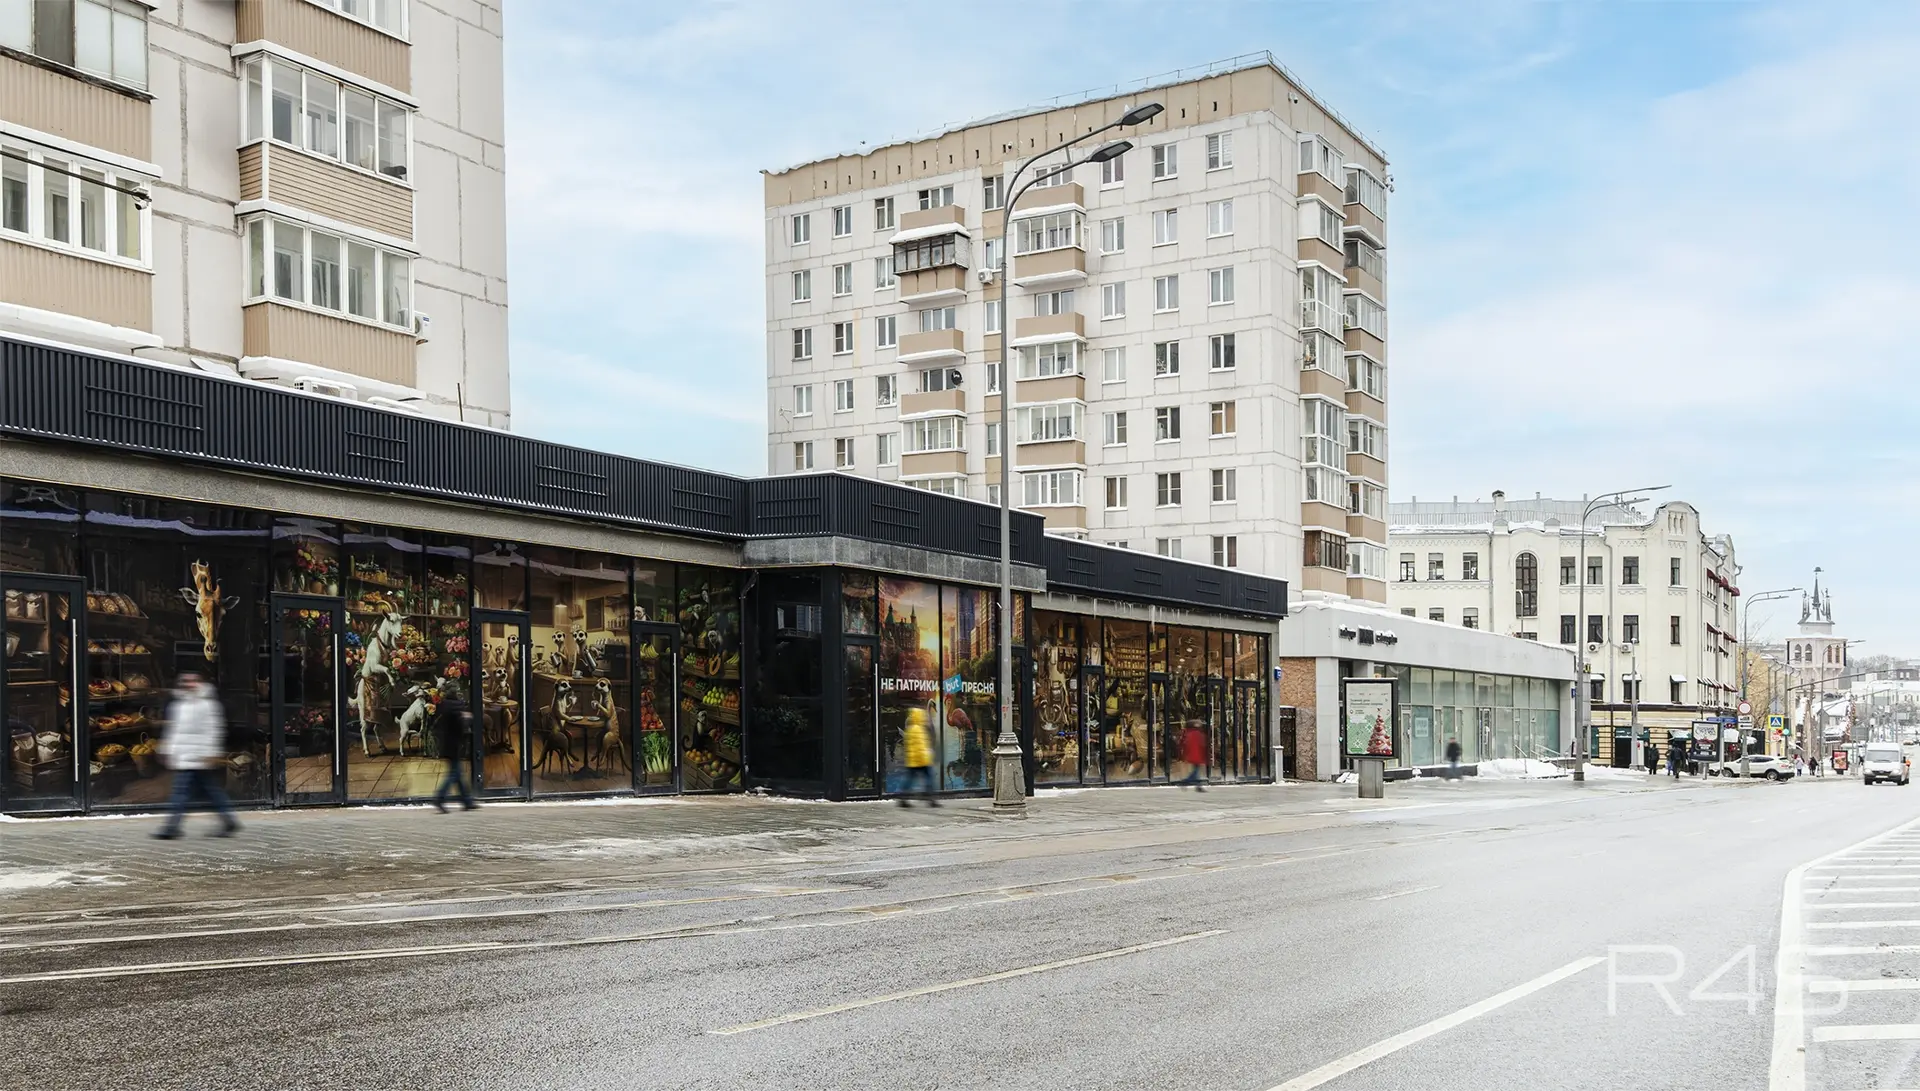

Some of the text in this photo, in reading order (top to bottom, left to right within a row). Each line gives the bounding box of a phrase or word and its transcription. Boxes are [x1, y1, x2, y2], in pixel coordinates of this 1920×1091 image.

[881, 677, 995, 694] НЕ ПАТРИКИ but ПРЕСНЯ
